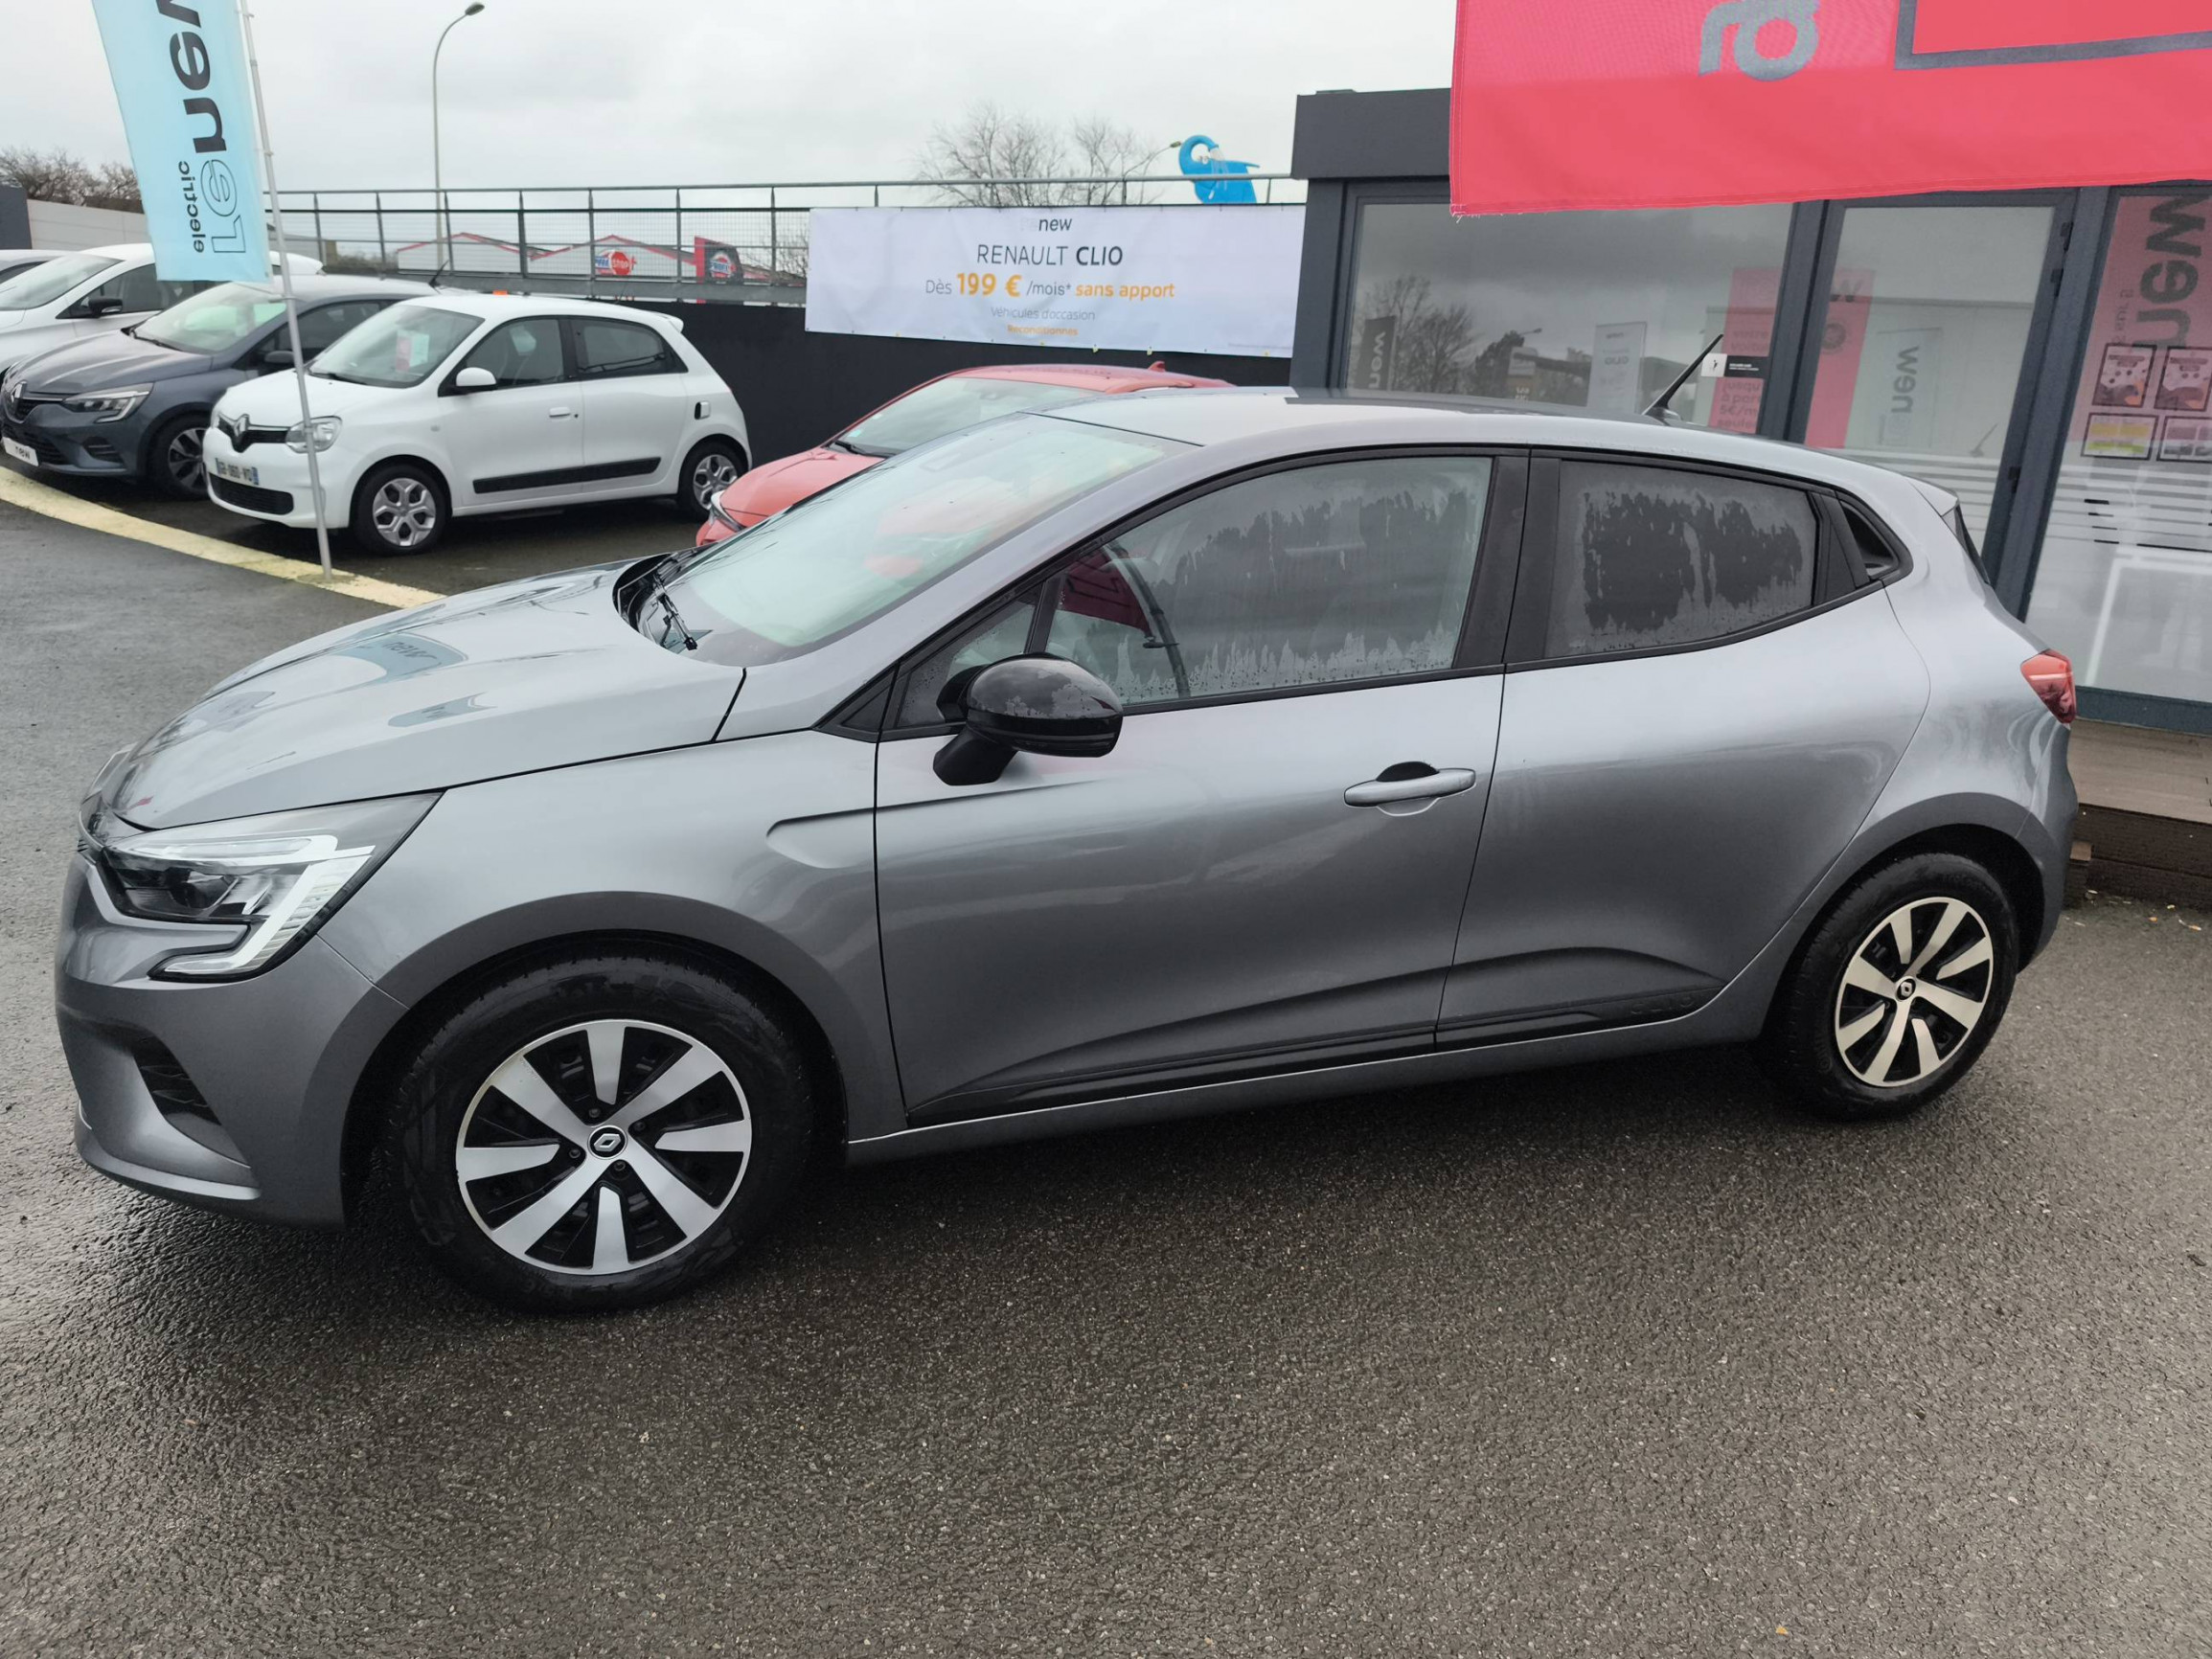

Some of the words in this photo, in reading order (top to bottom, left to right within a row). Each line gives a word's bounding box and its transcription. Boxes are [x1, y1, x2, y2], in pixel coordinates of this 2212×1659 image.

[976, 244, 1068, 265] RENAULT
[1075, 245, 1124, 266] CLIO
[925, 279, 953, 295] Dès
[956, 272, 996, 296] 199
[1005, 274, 1023, 297] €
[1075, 284, 1114, 297] sans
[1118, 284, 1175, 301] apport
